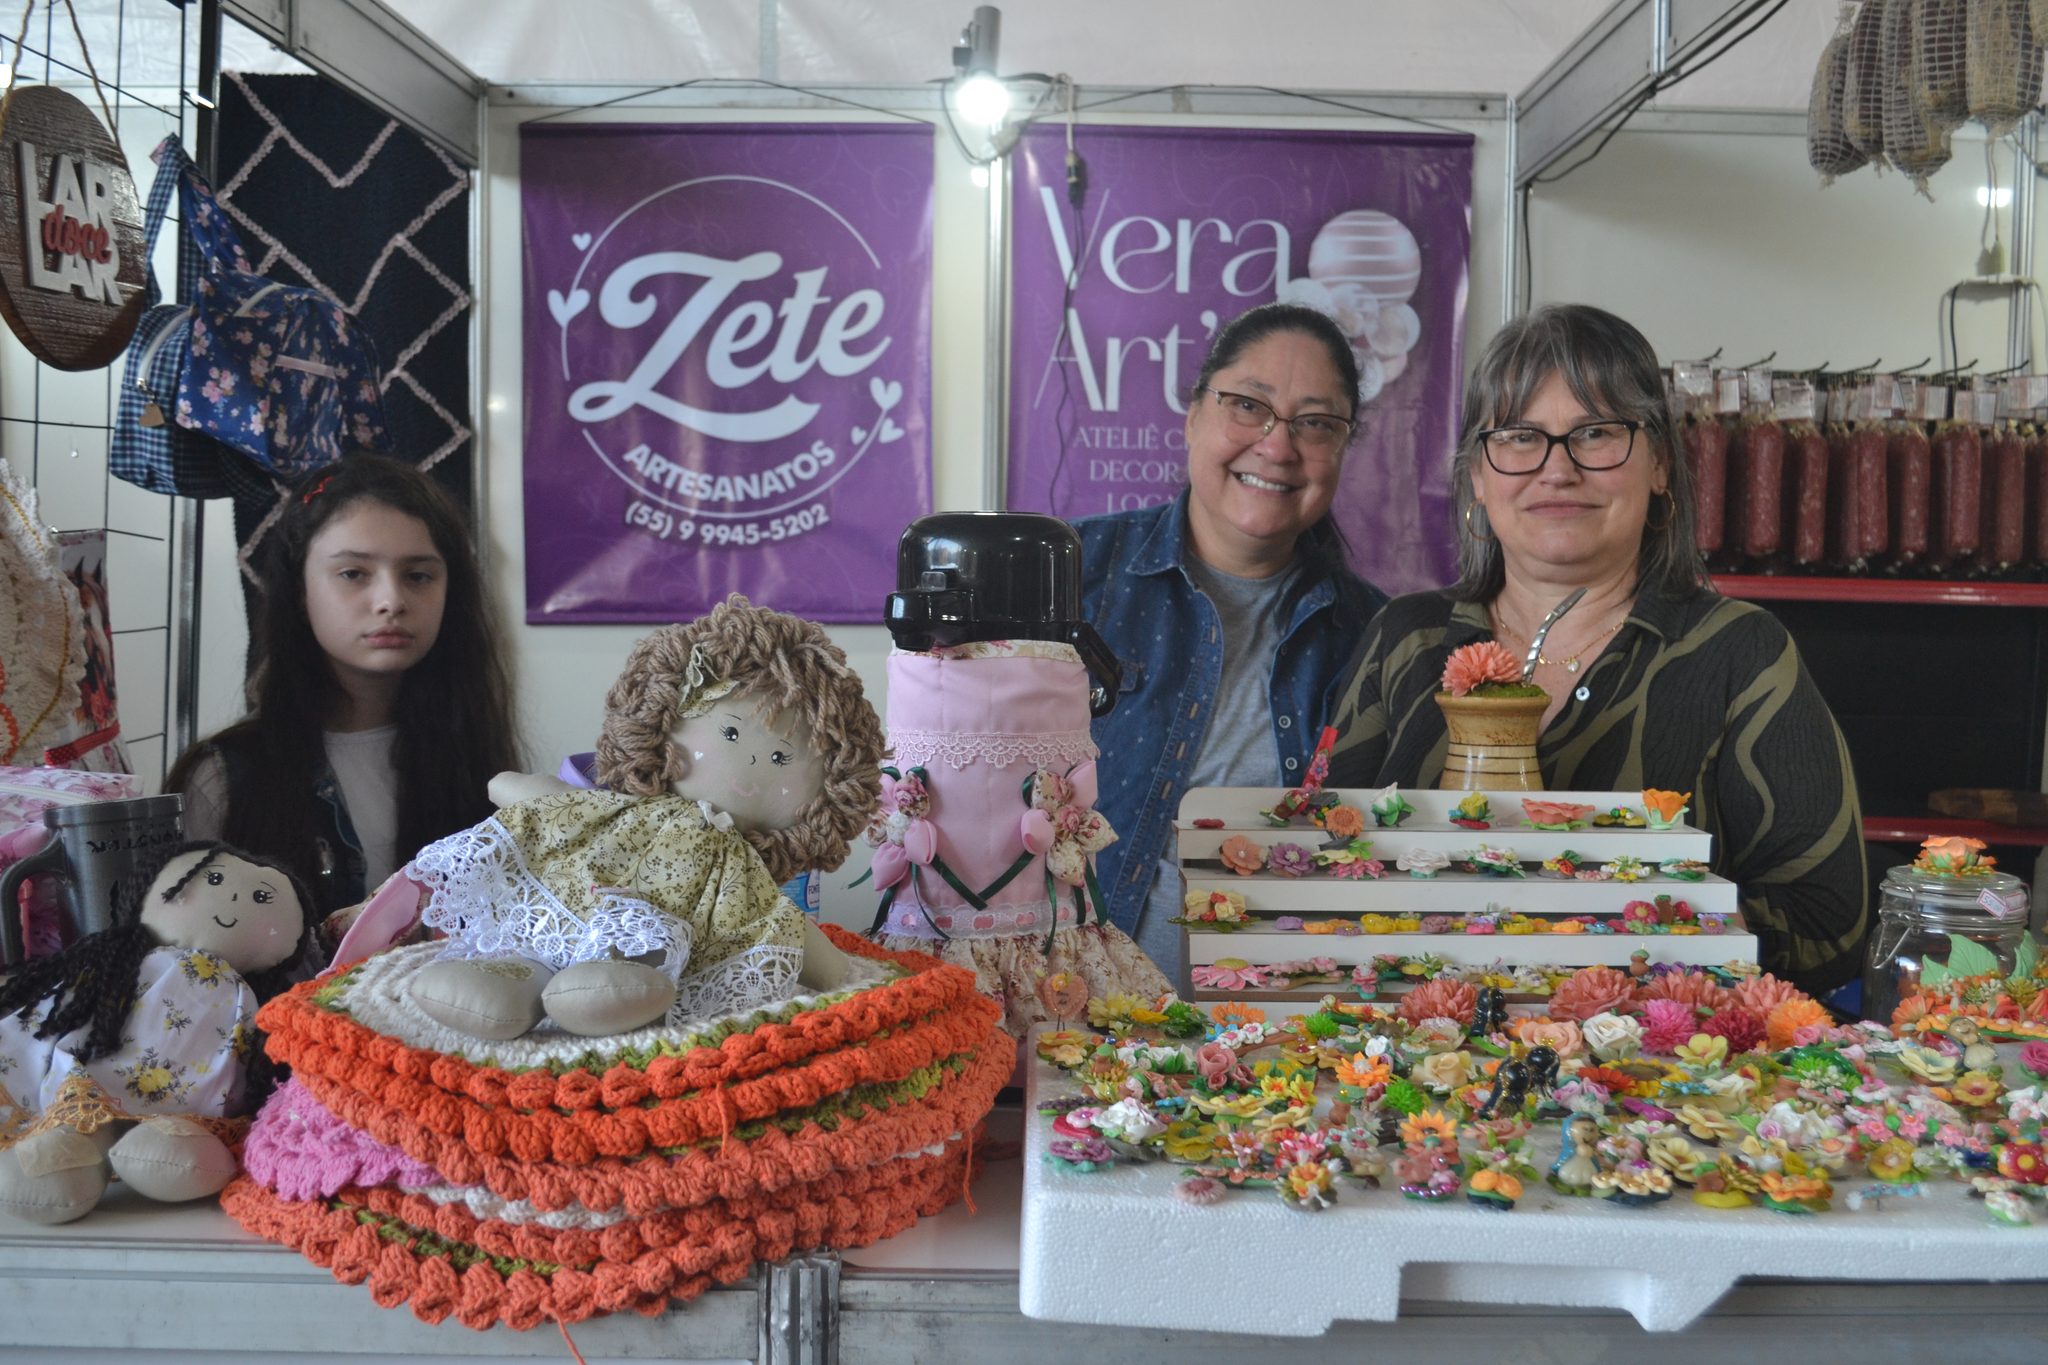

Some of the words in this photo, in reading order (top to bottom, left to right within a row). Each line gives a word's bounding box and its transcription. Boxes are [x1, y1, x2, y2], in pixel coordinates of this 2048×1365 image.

[20, 141, 117, 228] LAR
[26, 208, 125, 306] LAR
[44, 204, 113, 264] doce
[1040, 186, 1291, 301] Vera
[568, 251, 891, 442] Zete
[622, 440, 836, 502] ARTESANATOS
[1072, 422, 1160, 450] ATELIÊ
[625, 500, 673, 539] (55)
[678, 519, 695, 541] 9
[700, 503, 829, 545] 9945-5202
